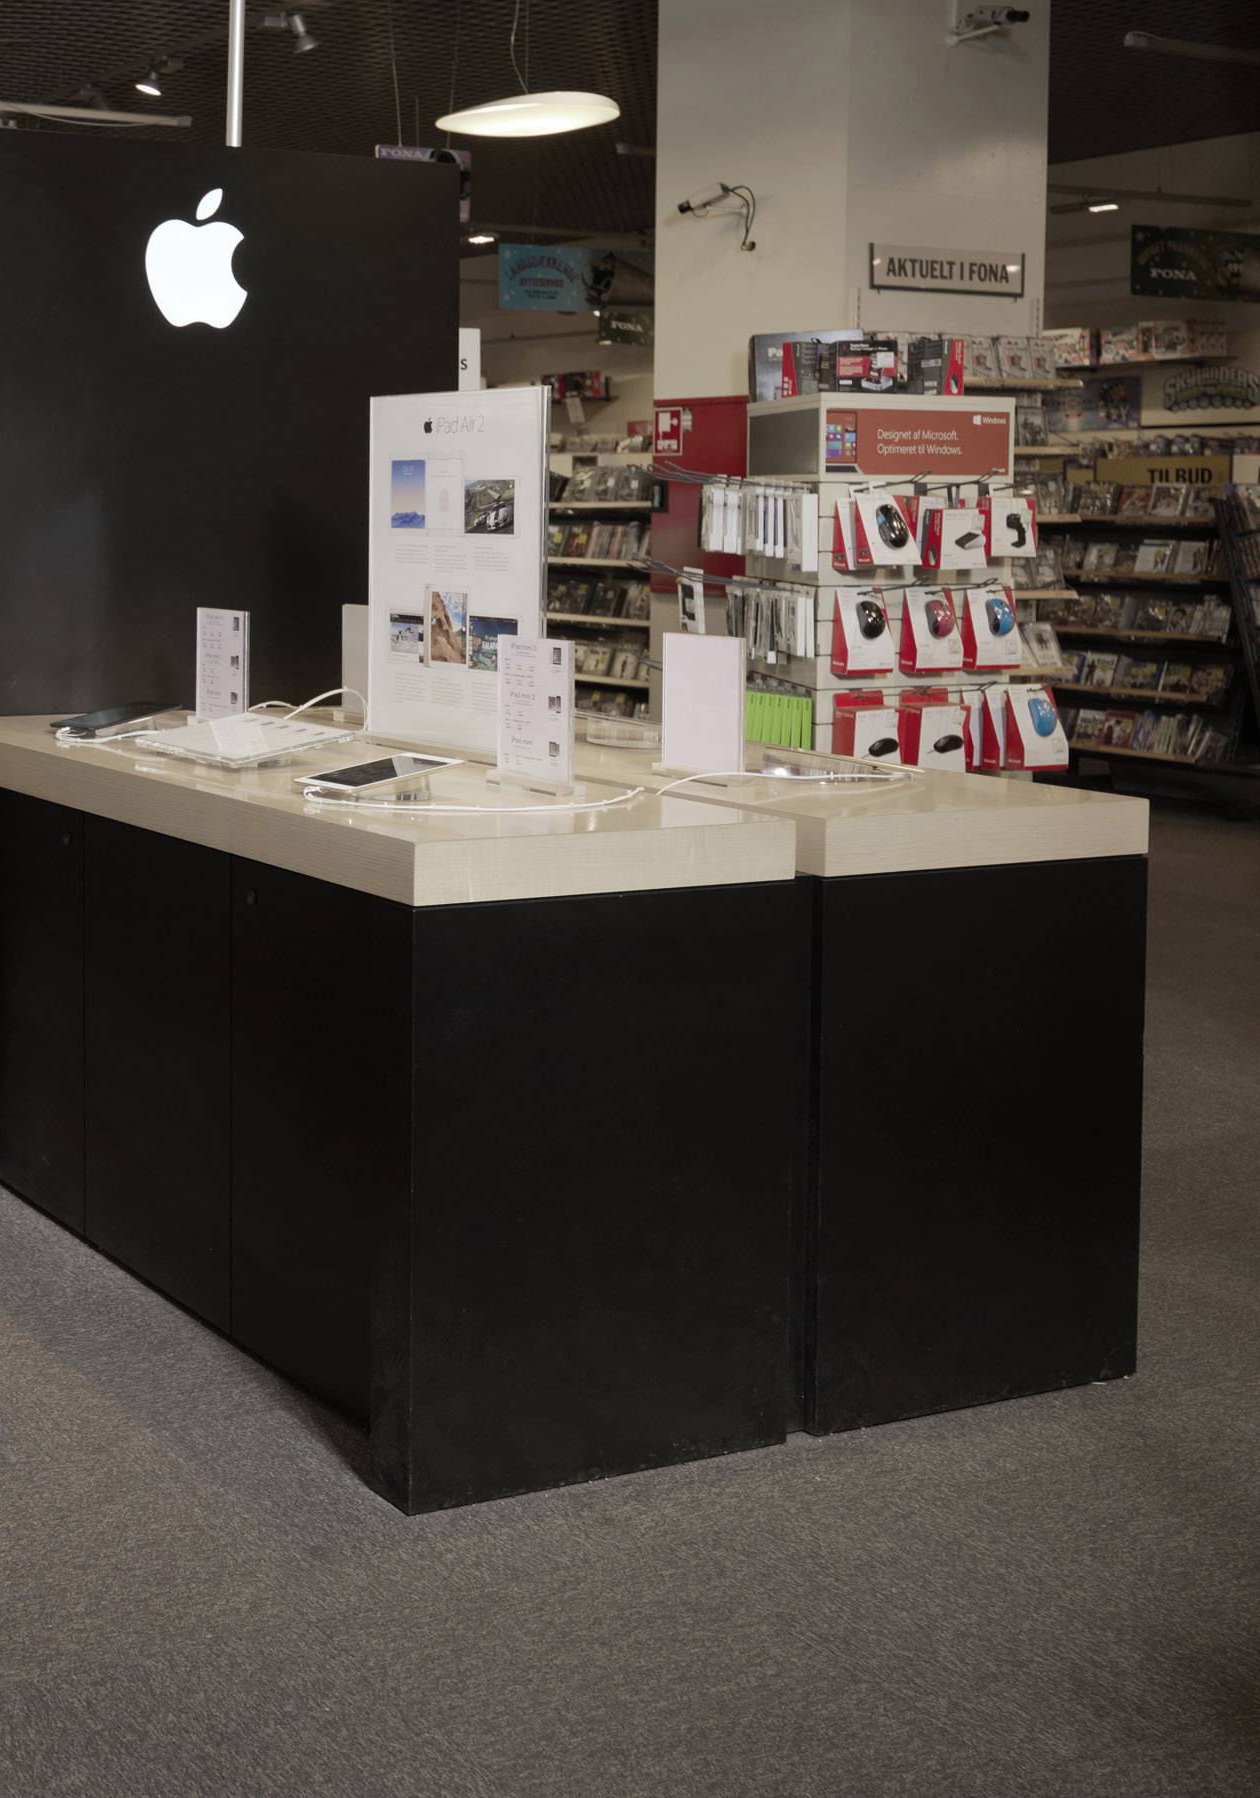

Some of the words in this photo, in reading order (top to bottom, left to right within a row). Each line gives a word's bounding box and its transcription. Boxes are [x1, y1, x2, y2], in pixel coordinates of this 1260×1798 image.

[886, 257, 956, 280] AKTUELT
[960, 262, 965, 281] I
[969, 261, 1009, 284] FONA
[1150, 267, 1197, 280] FONA
[436, 416, 459, 434] iPad
[460, 415, 476, 433] Air
[477, 415, 485, 433] 2
[982, 416, 1007, 425] Windows
[877, 428, 911, 442] Designet
[912, 428, 921, 440] af
[922, 428, 959, 440] Microsoft.
[877, 443, 917, 456] Optimeret
[926, 444, 963, 455] Windows.
[1147, 467, 1213, 484] TILBUD
